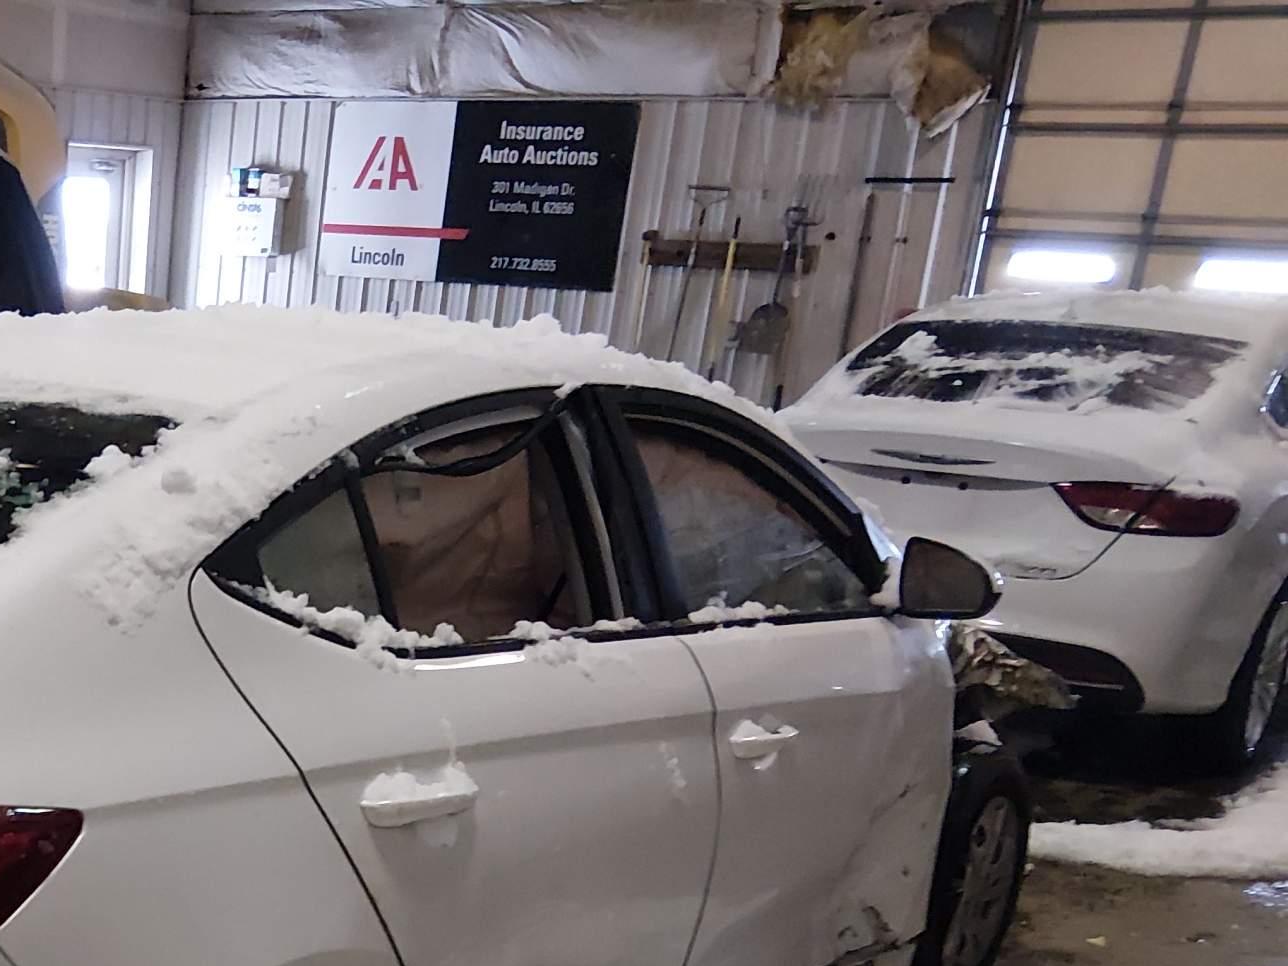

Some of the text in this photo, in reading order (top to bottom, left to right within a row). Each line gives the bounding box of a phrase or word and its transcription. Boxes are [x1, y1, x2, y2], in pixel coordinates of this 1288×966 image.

[499, 120, 585, 140] Insurance
[479, 144, 599, 166] Auto Auctions
[351, 246, 405, 266] Lincoln
